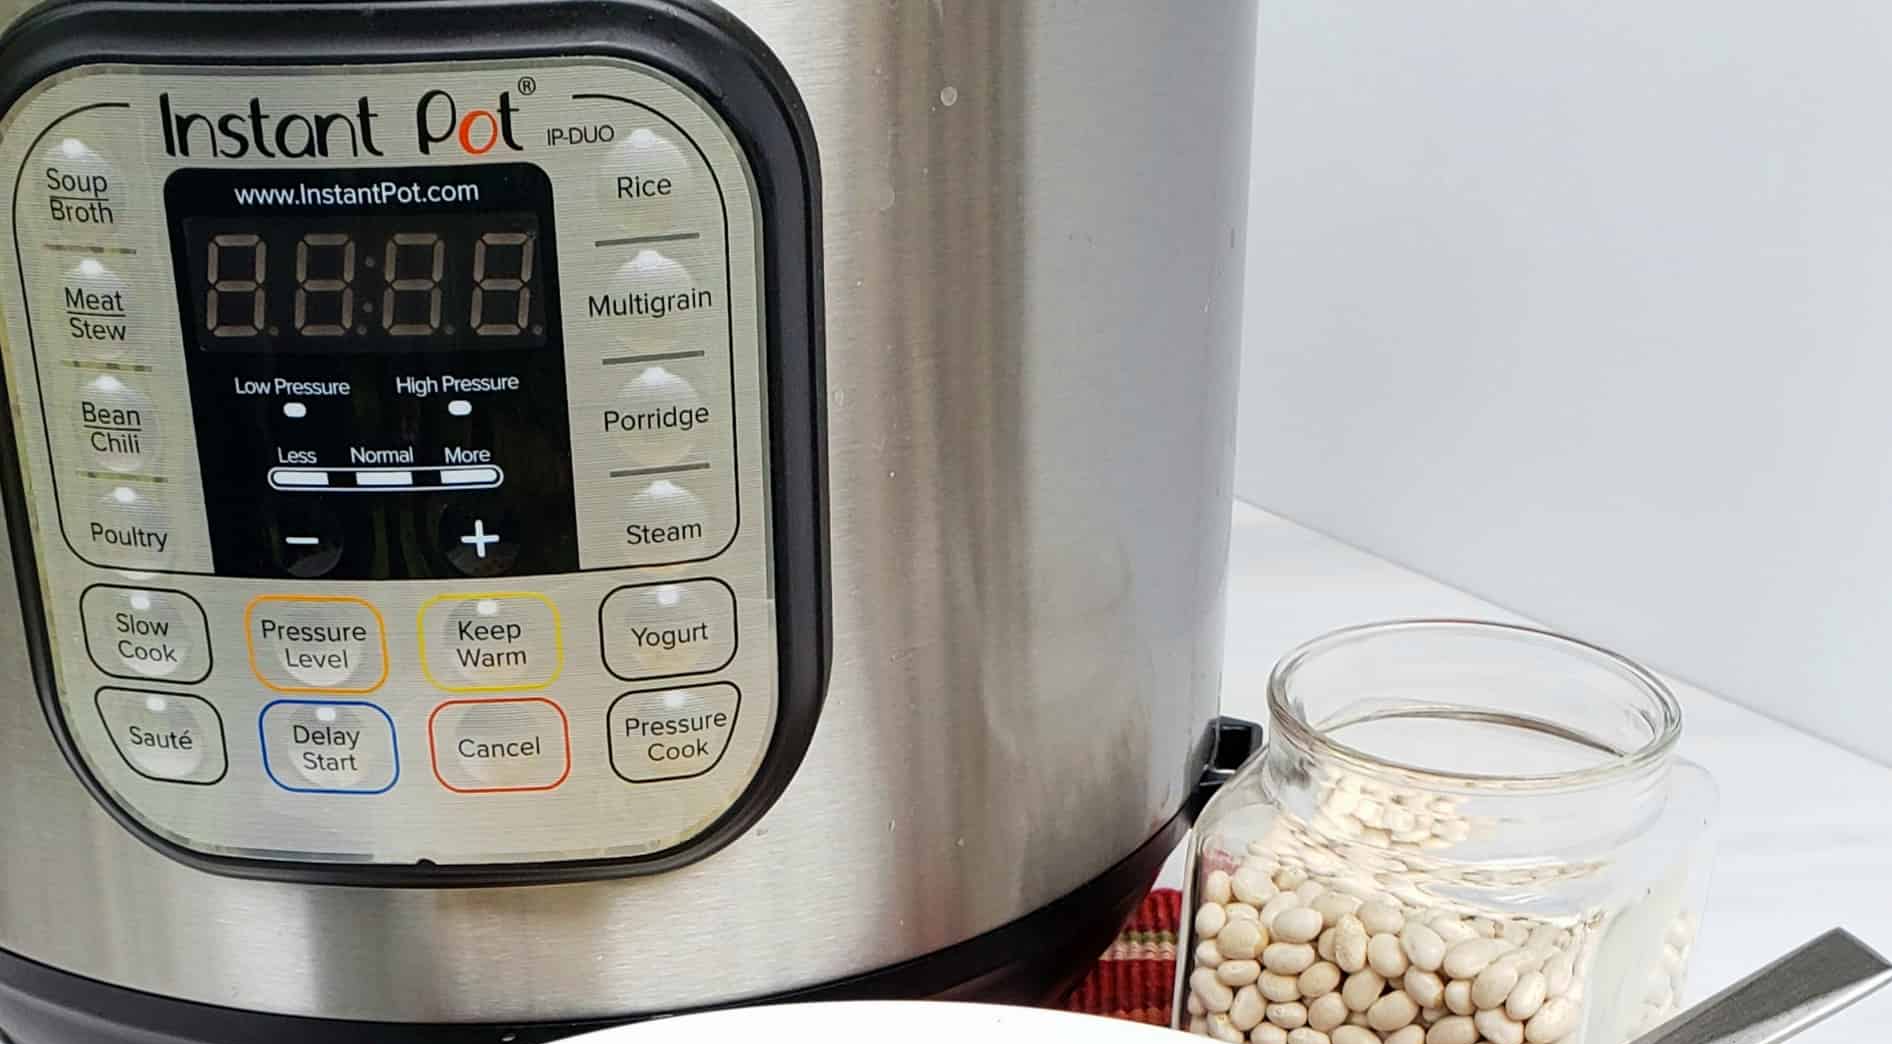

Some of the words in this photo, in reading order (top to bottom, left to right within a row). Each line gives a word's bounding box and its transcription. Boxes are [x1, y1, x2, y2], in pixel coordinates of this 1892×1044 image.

[159, 92, 384, 157] Instant
[546, 125, 615, 147] IP-DUO
[46, 168, 108, 195] Soup
[234, 181, 480, 206] www.InstantPot.com
[616, 176, 673, 199] Rice
[50, 200, 114, 224] Broth
[65, 286, 123, 312] Meat
[588, 288, 713, 318] Multigrain
[69, 316, 127, 341] Stew
[234, 377, 274, 395] Low
[274, 378, 351, 396] Pressure
[396, 375, 439, 396] High
[442, 374, 520, 393] Pressure
[81, 401, 142, 426] Bean
[603, 404, 711, 433] Porridge
[90, 431, 141, 454] Chili
[277, 446, 317, 464] Less
[351, 446, 414, 464] Normal
[444, 446, 491, 463] More
[90, 521, 168, 553] Poultry
[625, 521, 703, 545] Steam
[115, 612, 169, 637] Slow
[260, 619, 367, 644] Pressure
[457, 619, 522, 647] Keep
[630, 622, 709, 651] Yogurt
[117, 638, 178, 664] Cook
[284, 647, 350, 670] Level
[456, 646, 528, 668] Warm
[292, 723, 360, 750] Delay
[624, 710, 727, 738] Pressure
[128, 724, 193, 751] Sauté
[457, 734, 541, 760] Cancel
[302, 749, 358, 772] Start
[647, 738, 710, 763] Cook
